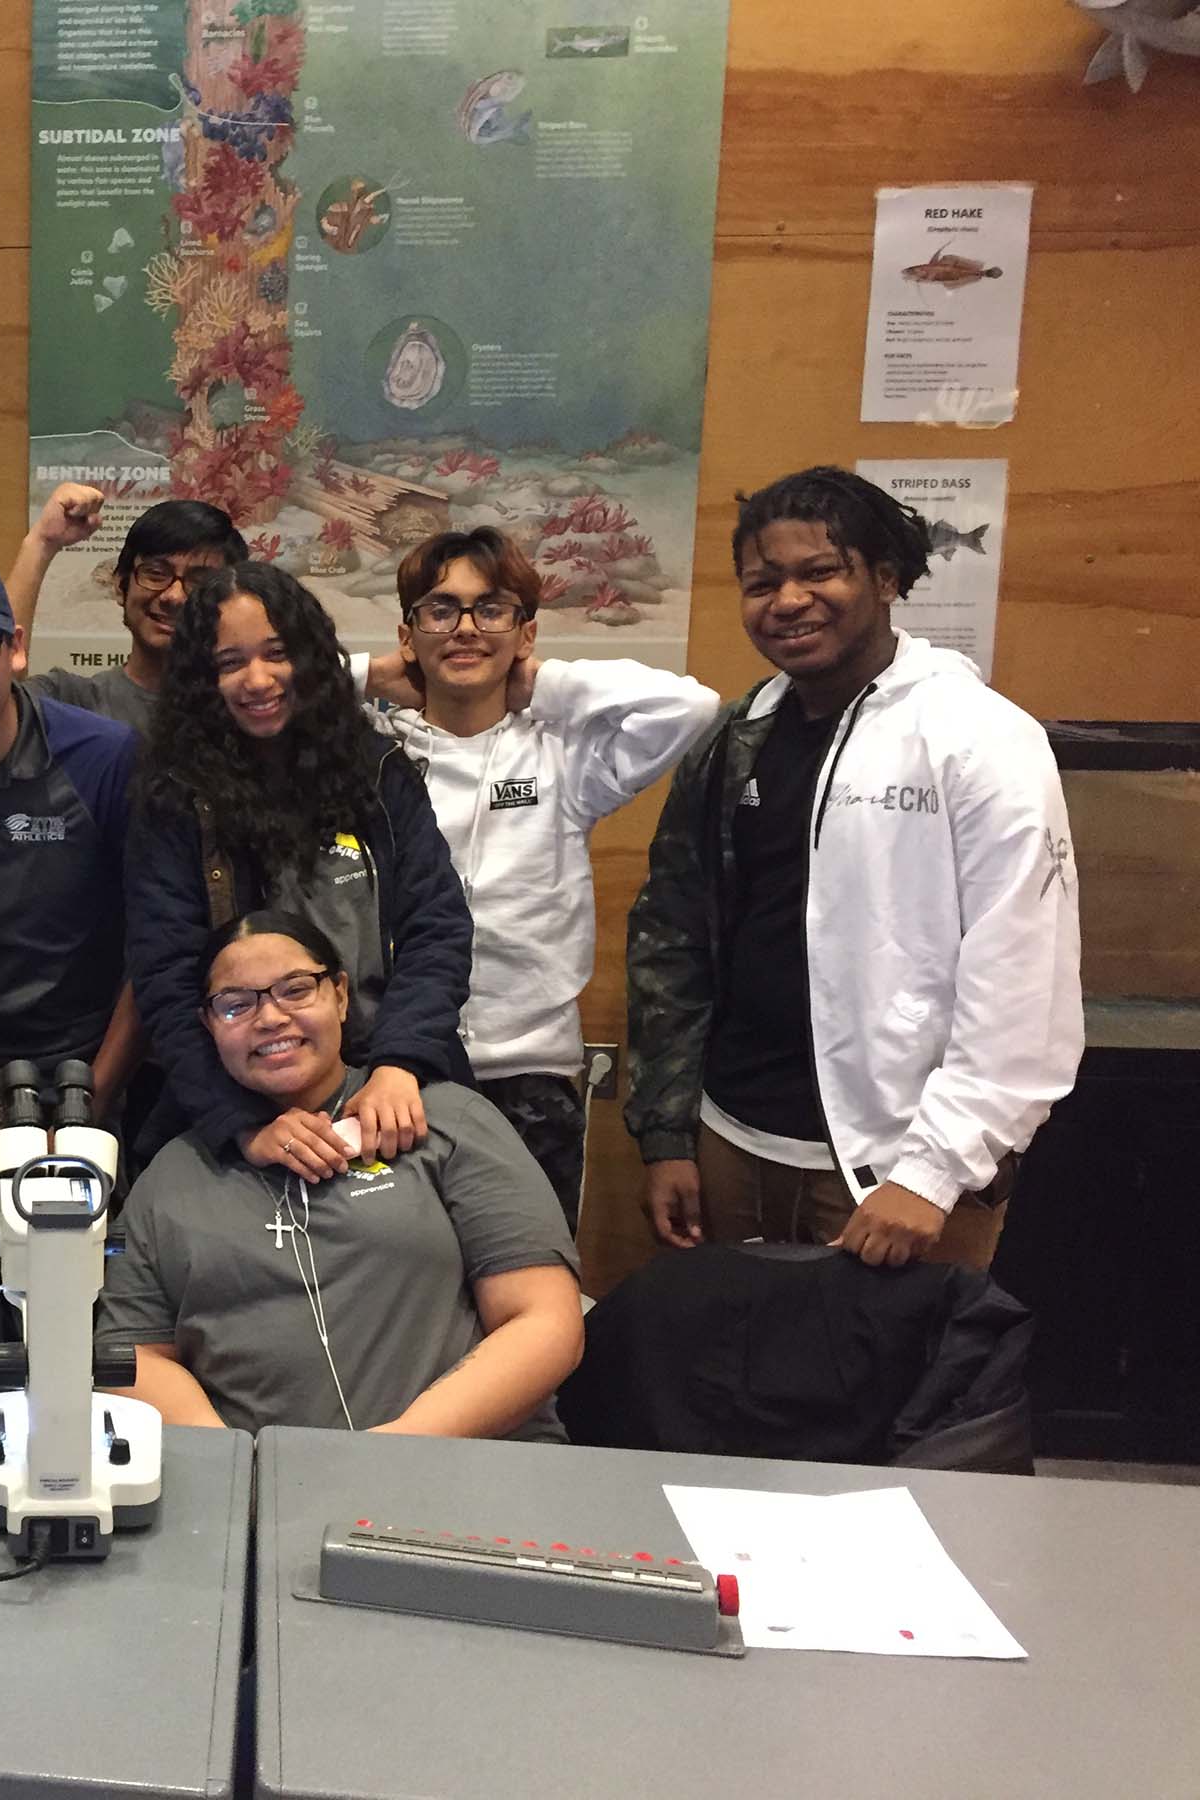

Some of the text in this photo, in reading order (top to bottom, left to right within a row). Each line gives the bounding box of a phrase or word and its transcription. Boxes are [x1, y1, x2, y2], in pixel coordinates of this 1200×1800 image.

[39, 128, 180, 144] SUBTIDAL ZONE
[924, 208, 983, 218] RED HAKE
[37, 466, 170, 480] BENTHIC ZONE
[891, 478, 971, 488] STRIPED BASS
[70, 653, 102, 666] THE
[494, 780, 534, 800] VANS
[11, 832, 64, 841] ATHLETICS
